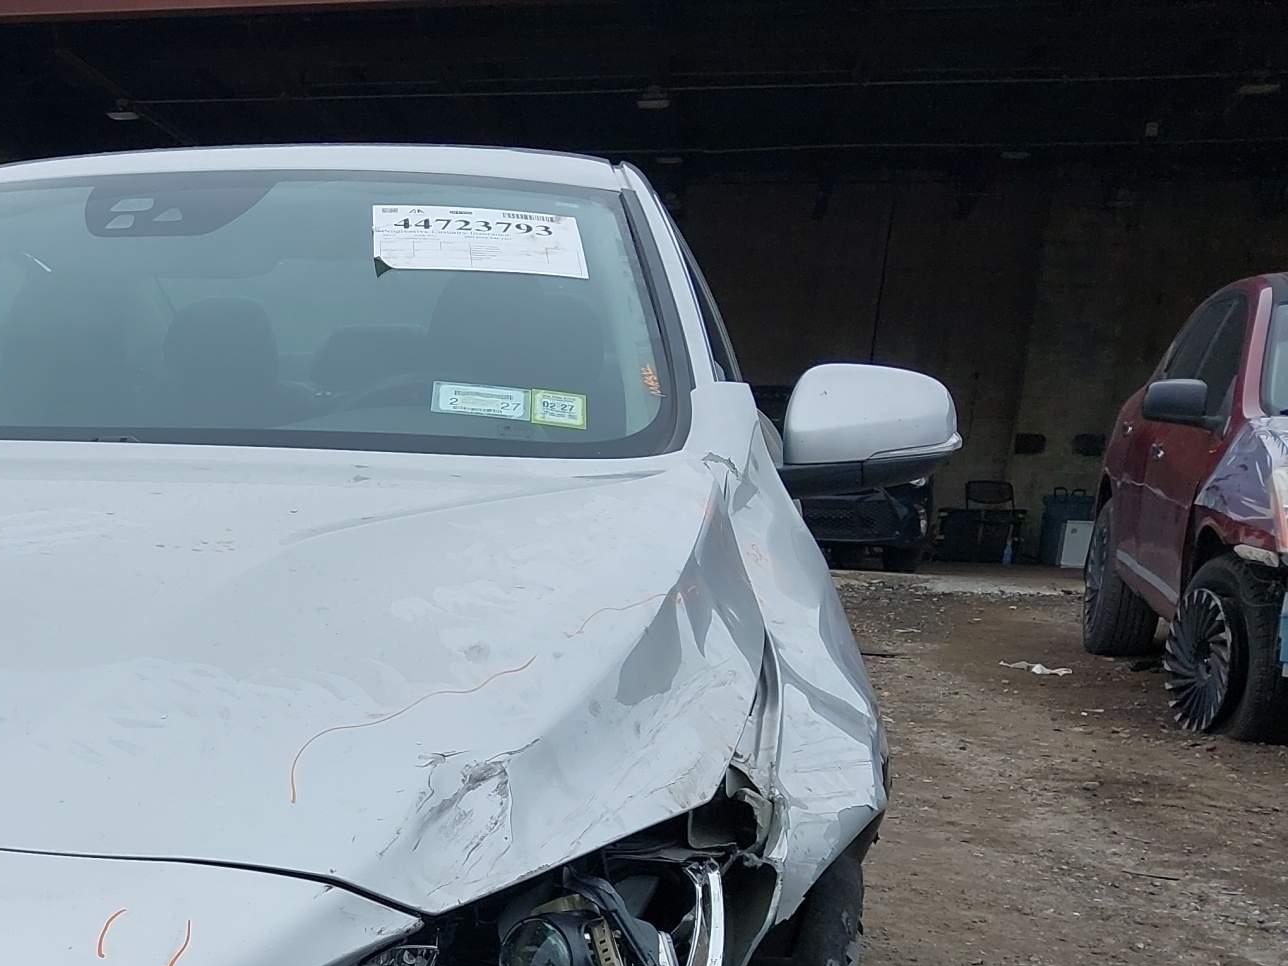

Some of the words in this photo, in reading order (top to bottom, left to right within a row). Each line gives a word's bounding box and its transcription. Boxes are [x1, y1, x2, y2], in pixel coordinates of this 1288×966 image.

[393, 217, 554, 237] 44723793
[448, 397, 459, 406] 2
[500, 402, 522, 411] 27
